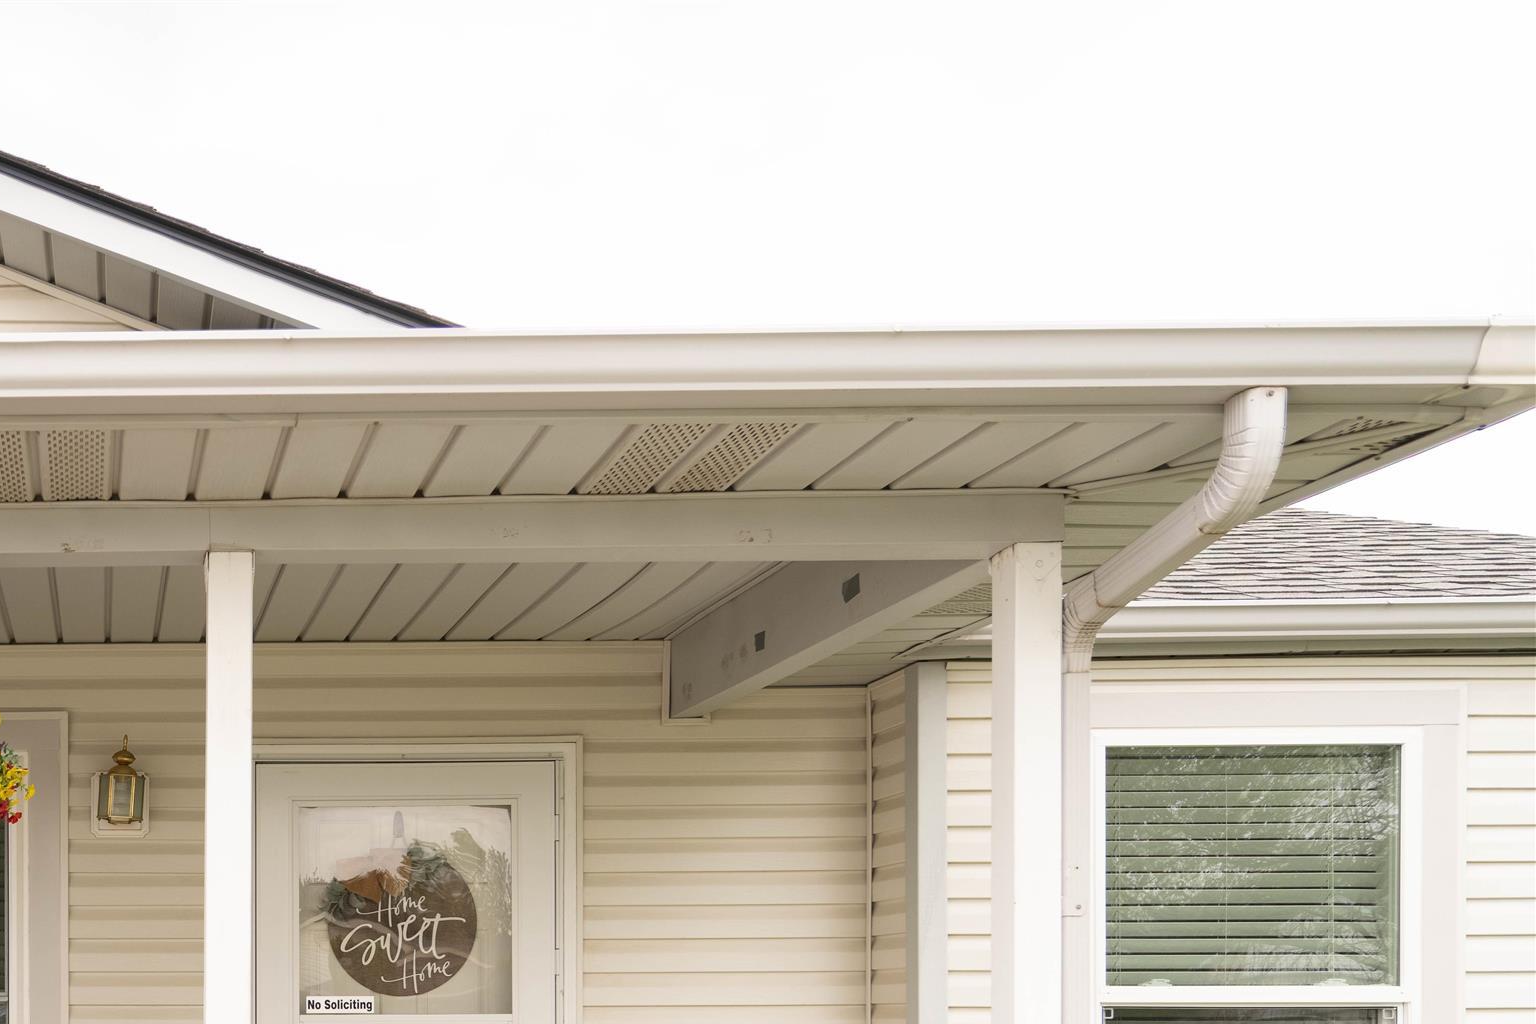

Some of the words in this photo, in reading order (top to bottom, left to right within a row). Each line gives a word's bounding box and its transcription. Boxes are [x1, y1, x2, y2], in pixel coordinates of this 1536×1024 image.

[356, 892, 429, 928] Home
[339, 912, 466, 966] Sweet
[380, 949, 454, 994] Home
[307, 999, 321, 1010] No
[324, 999, 373, 1012] Soliciting
